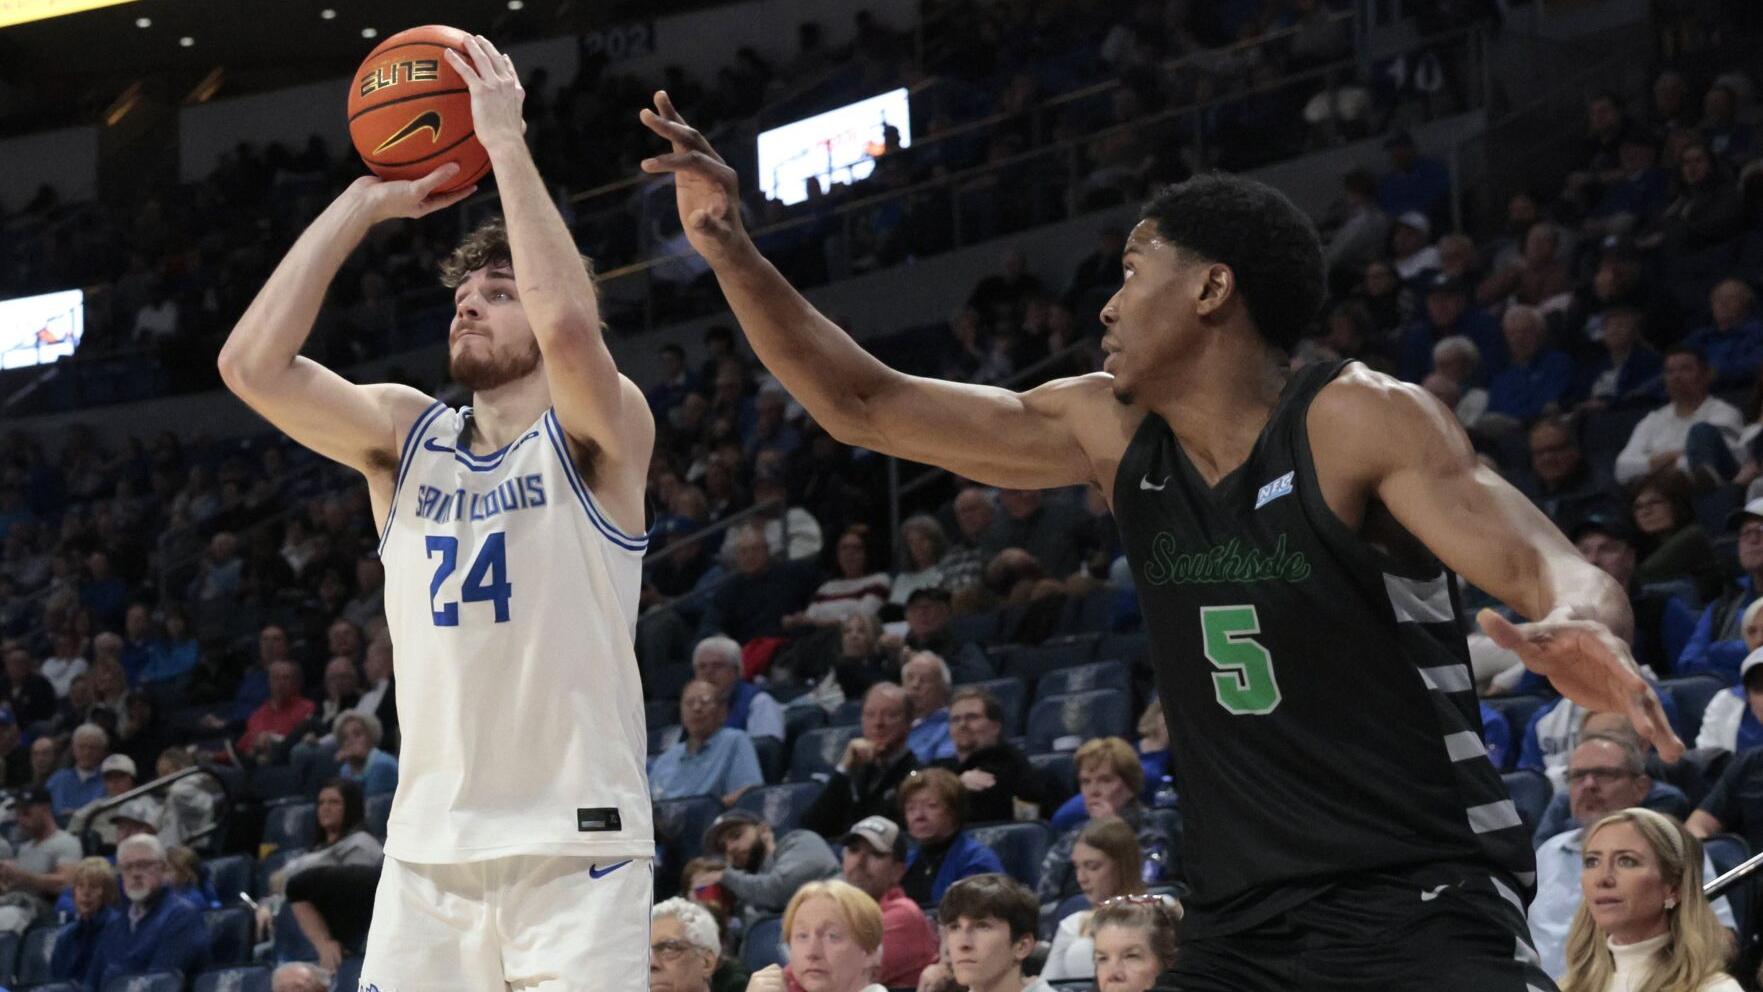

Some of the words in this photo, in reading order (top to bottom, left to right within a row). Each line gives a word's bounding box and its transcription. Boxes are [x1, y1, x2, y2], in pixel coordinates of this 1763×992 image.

[361, 59, 438, 97] ELITE
[470, 473, 546, 522] LOUIS
[425, 531, 512, 627] 24
[1144, 531, 1312, 585] Southsde
[1200, 604, 1282, 715] 5
